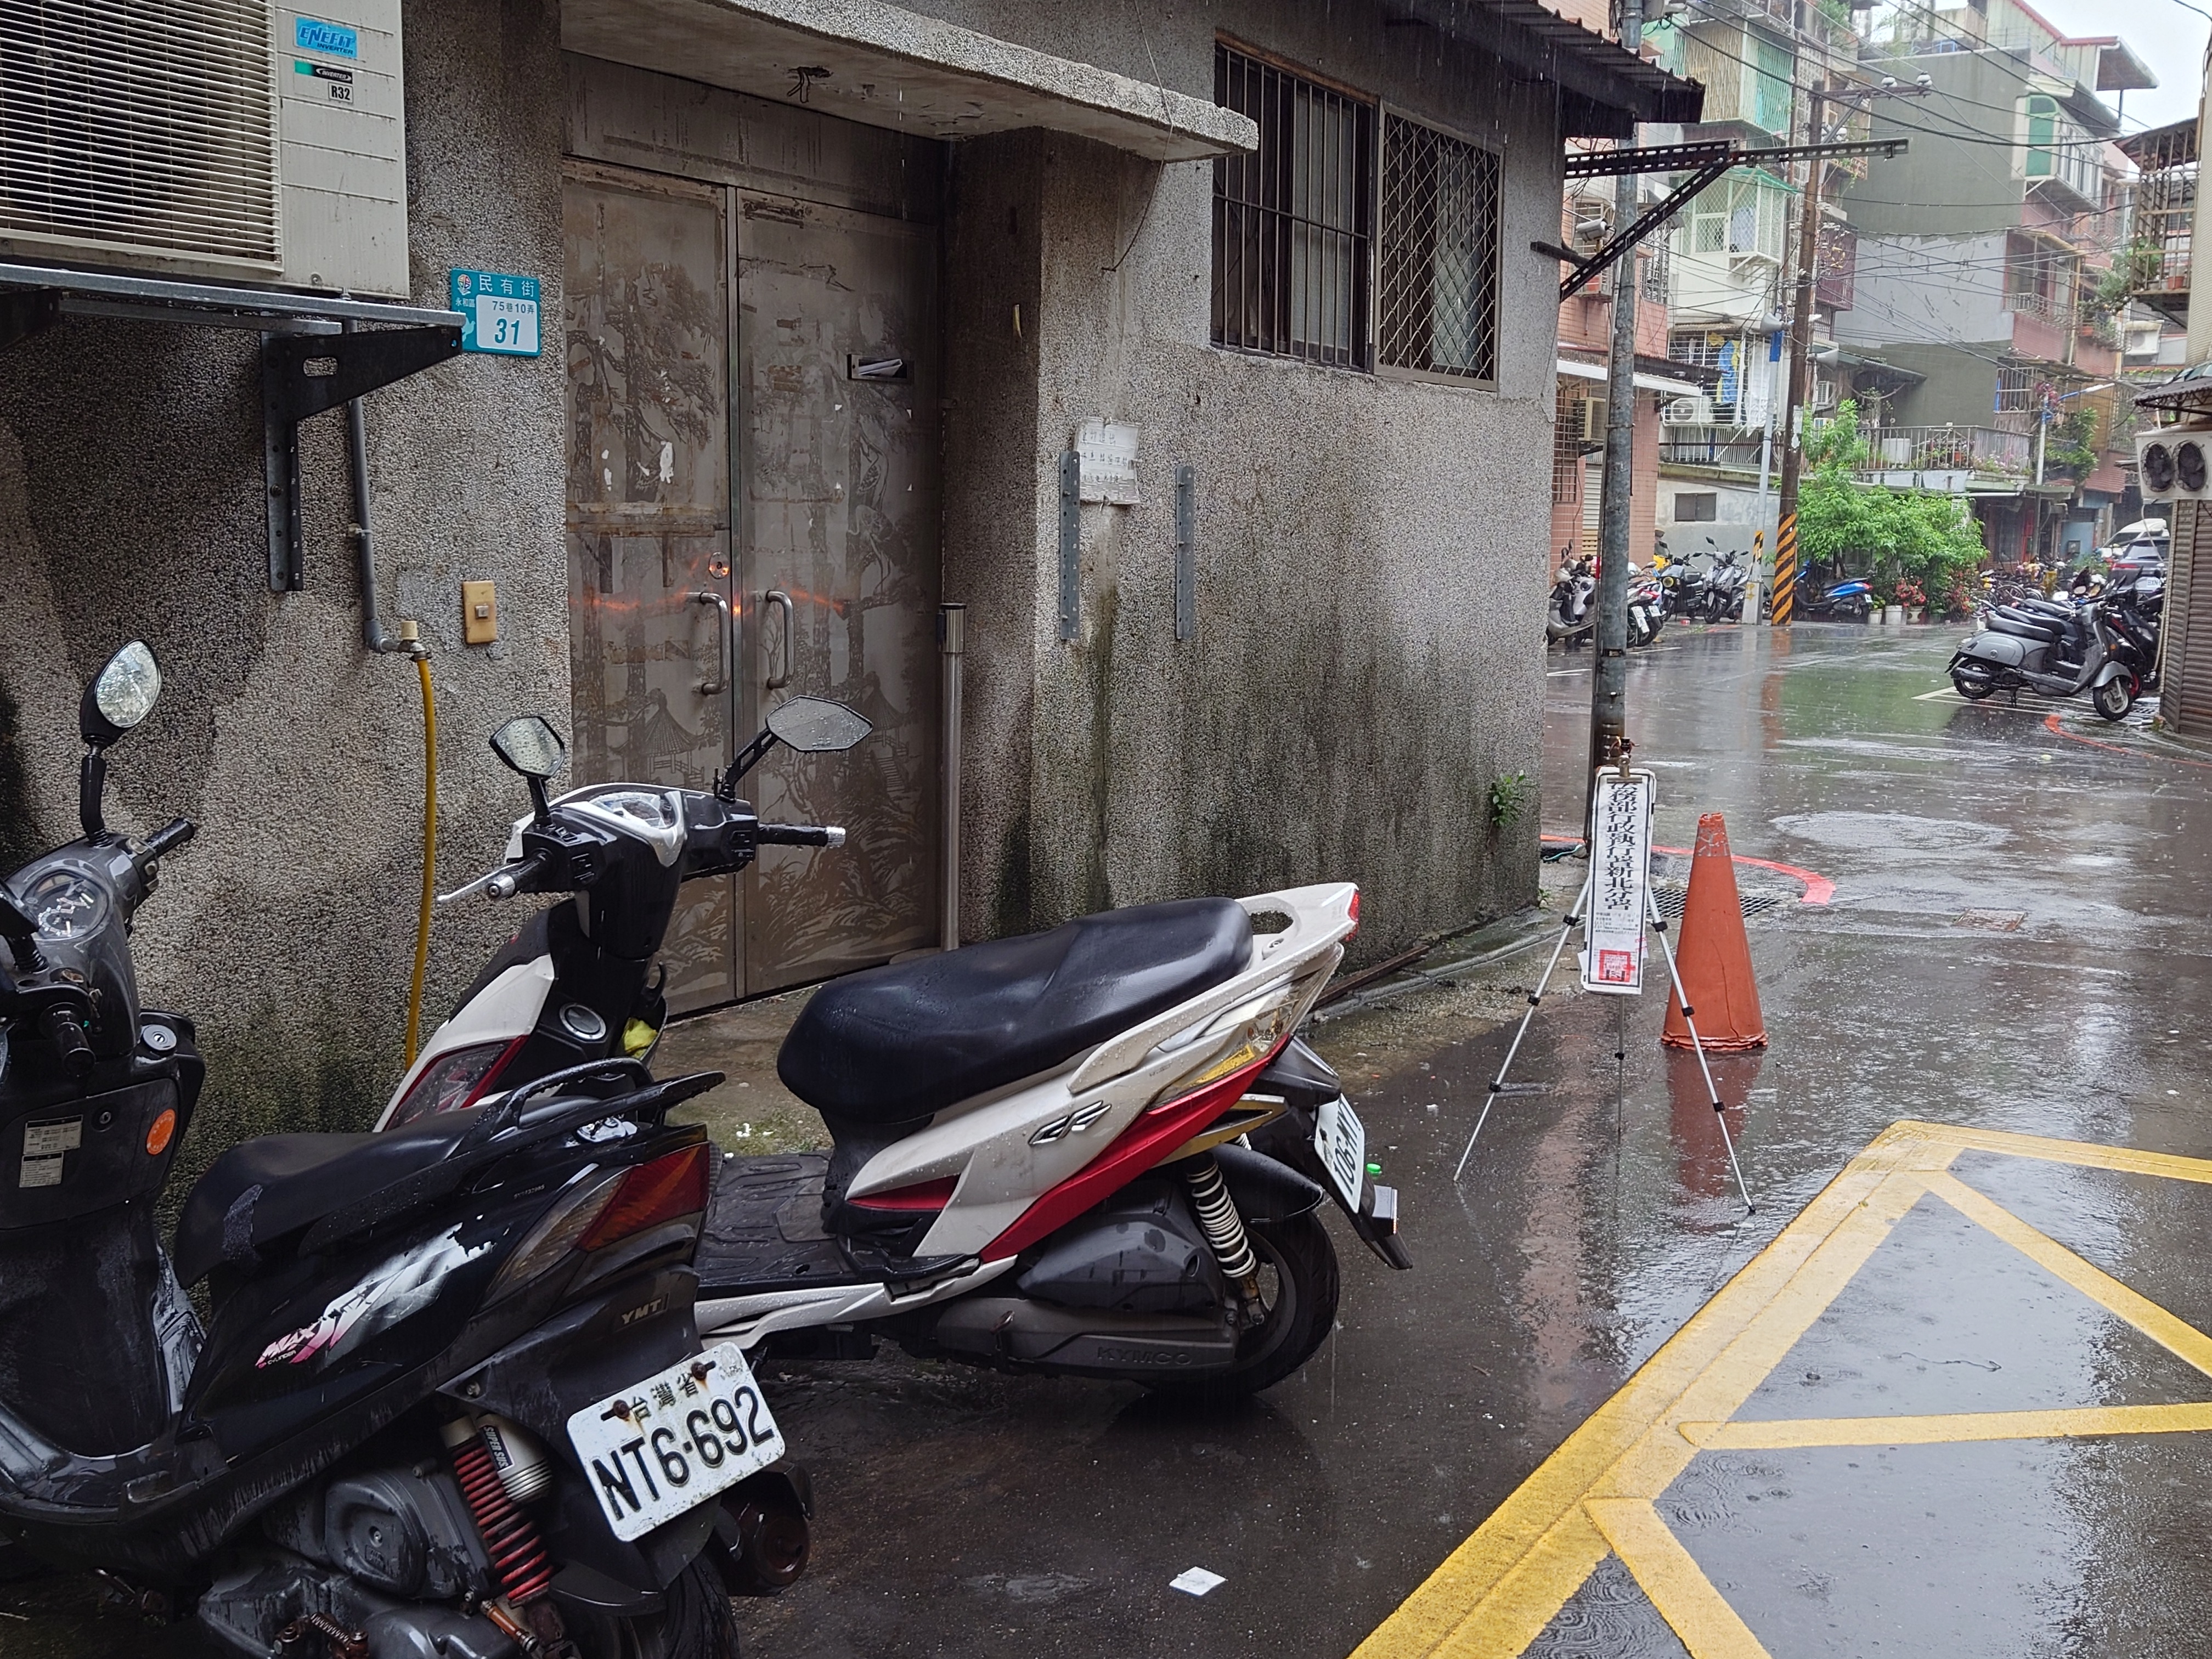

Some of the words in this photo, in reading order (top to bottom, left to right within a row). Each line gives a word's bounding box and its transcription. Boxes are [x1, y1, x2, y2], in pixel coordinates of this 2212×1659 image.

[300, 27, 353, 48] ENEFIT
[317, 43, 353, 55] INVERTER
[322, 70, 347, 79] INVERTER
[331, 86, 351, 100] R32
[479, 274, 535, 297] 民有街
[455, 297, 476, 308] 永和區
[492, 300, 534, 314] 75巷10弄
[494, 318, 520, 345] 31
[620, 1298, 662, 1324] YMT
[1098, 1346, 1193, 1365] KYMCO
[631, 1372, 699, 1422] 台灣省
[483, 1426, 502, 1451] SUPER
[591, 1385, 775, 1521] NT6-692
